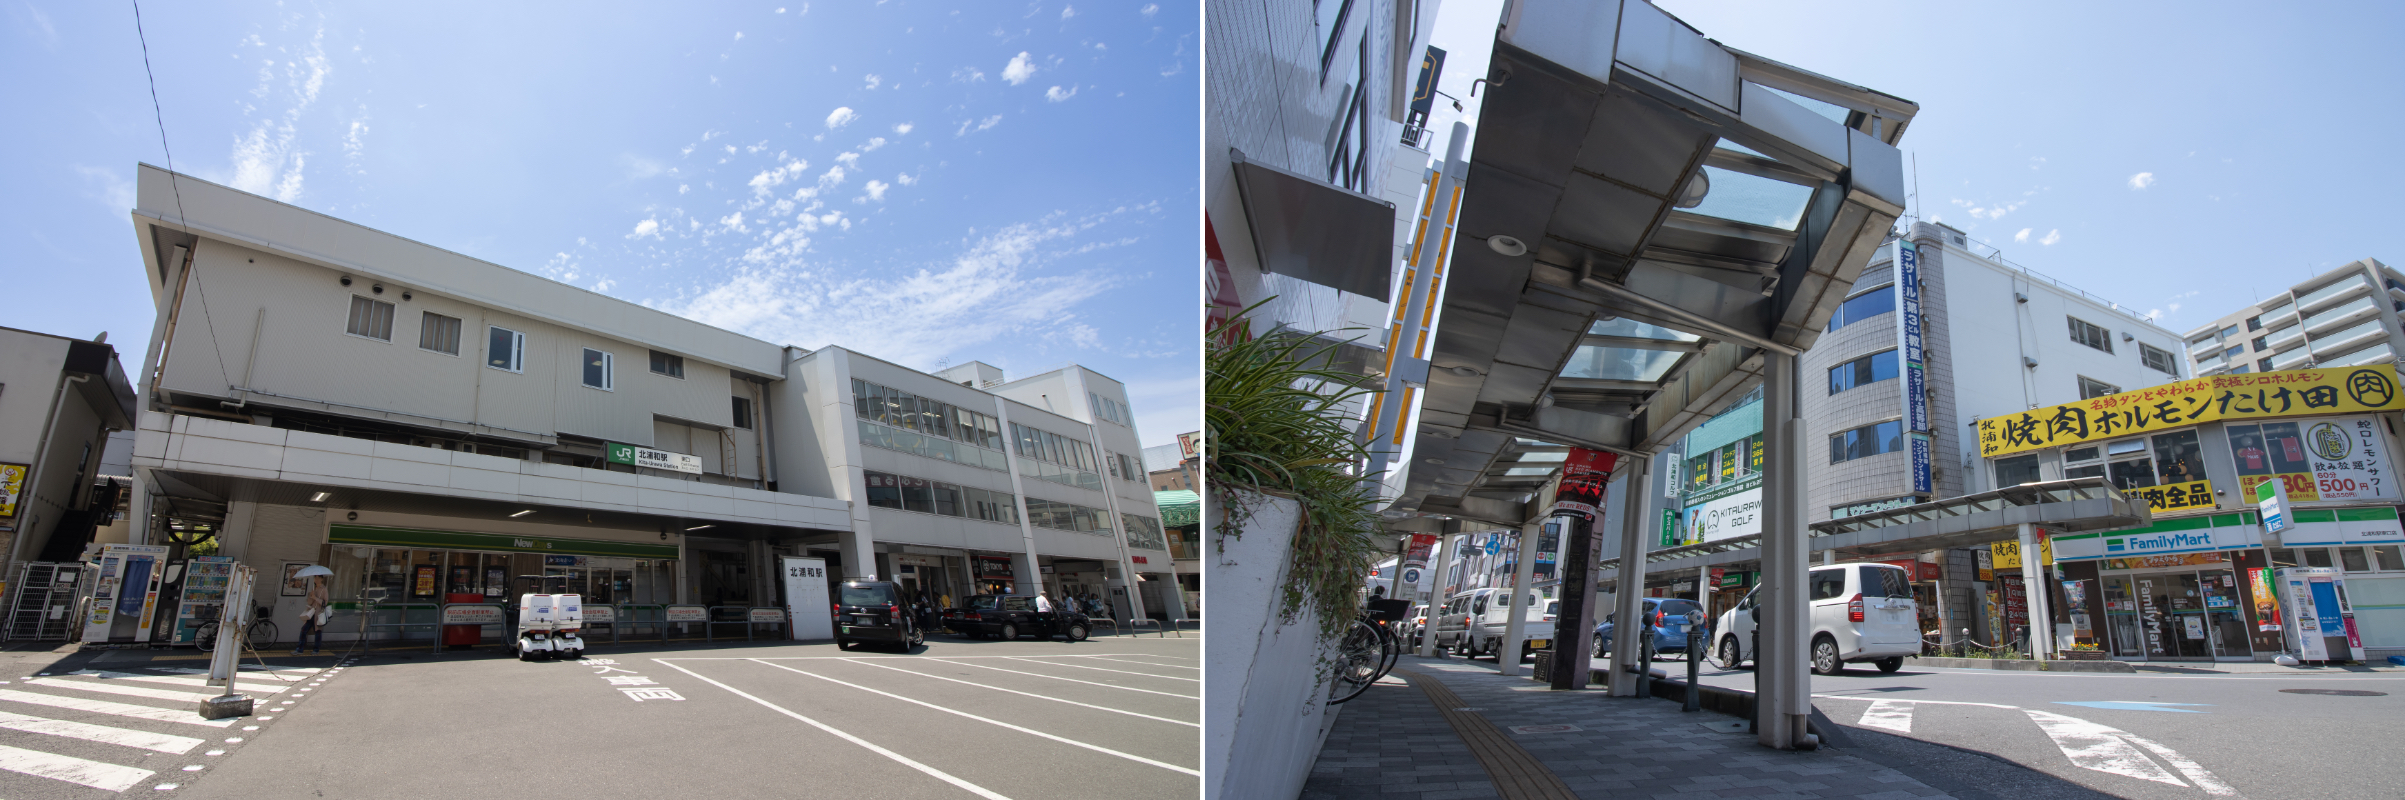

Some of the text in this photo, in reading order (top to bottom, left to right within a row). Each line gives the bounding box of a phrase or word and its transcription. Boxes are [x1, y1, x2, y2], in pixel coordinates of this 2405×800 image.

[2213, 371, 2325, 389] 究極シロホルモン
[2355, 373, 2388, 403] 肉
[2090, 380, 2210, 411] 名物タンとやわらか
[2002, 385, 2339, 450] 焼肉ホルモンたけ田
[1981, 420, 1998, 455] 北浦和
[616, 447, 631, 459] JR
[639, 449, 668, 462] 北浦和駅
[1722, 449, 1736, 459] インドア
[2357, 420, 2381, 496] 蛇口レモンサワー
[638, 459, 662, 467] Kita-Urawa
[663, 462, 679, 470] Station
[1723, 458, 1735, 468] ゴルフ
[2314, 460, 2365, 472] 飲み放題
[2260, 502, 2279, 514] FamilyMart
[1731, 514, 1754, 527] GOLF
[1664, 516, 1672, 545] モスバーガー
[513, 538, 553, 549] NewDays
[2129, 532, 2211, 550] FamilyMart
[789, 566, 823, 578] 北浦和駅
[2139, 579, 2164, 653] FamilyMart
